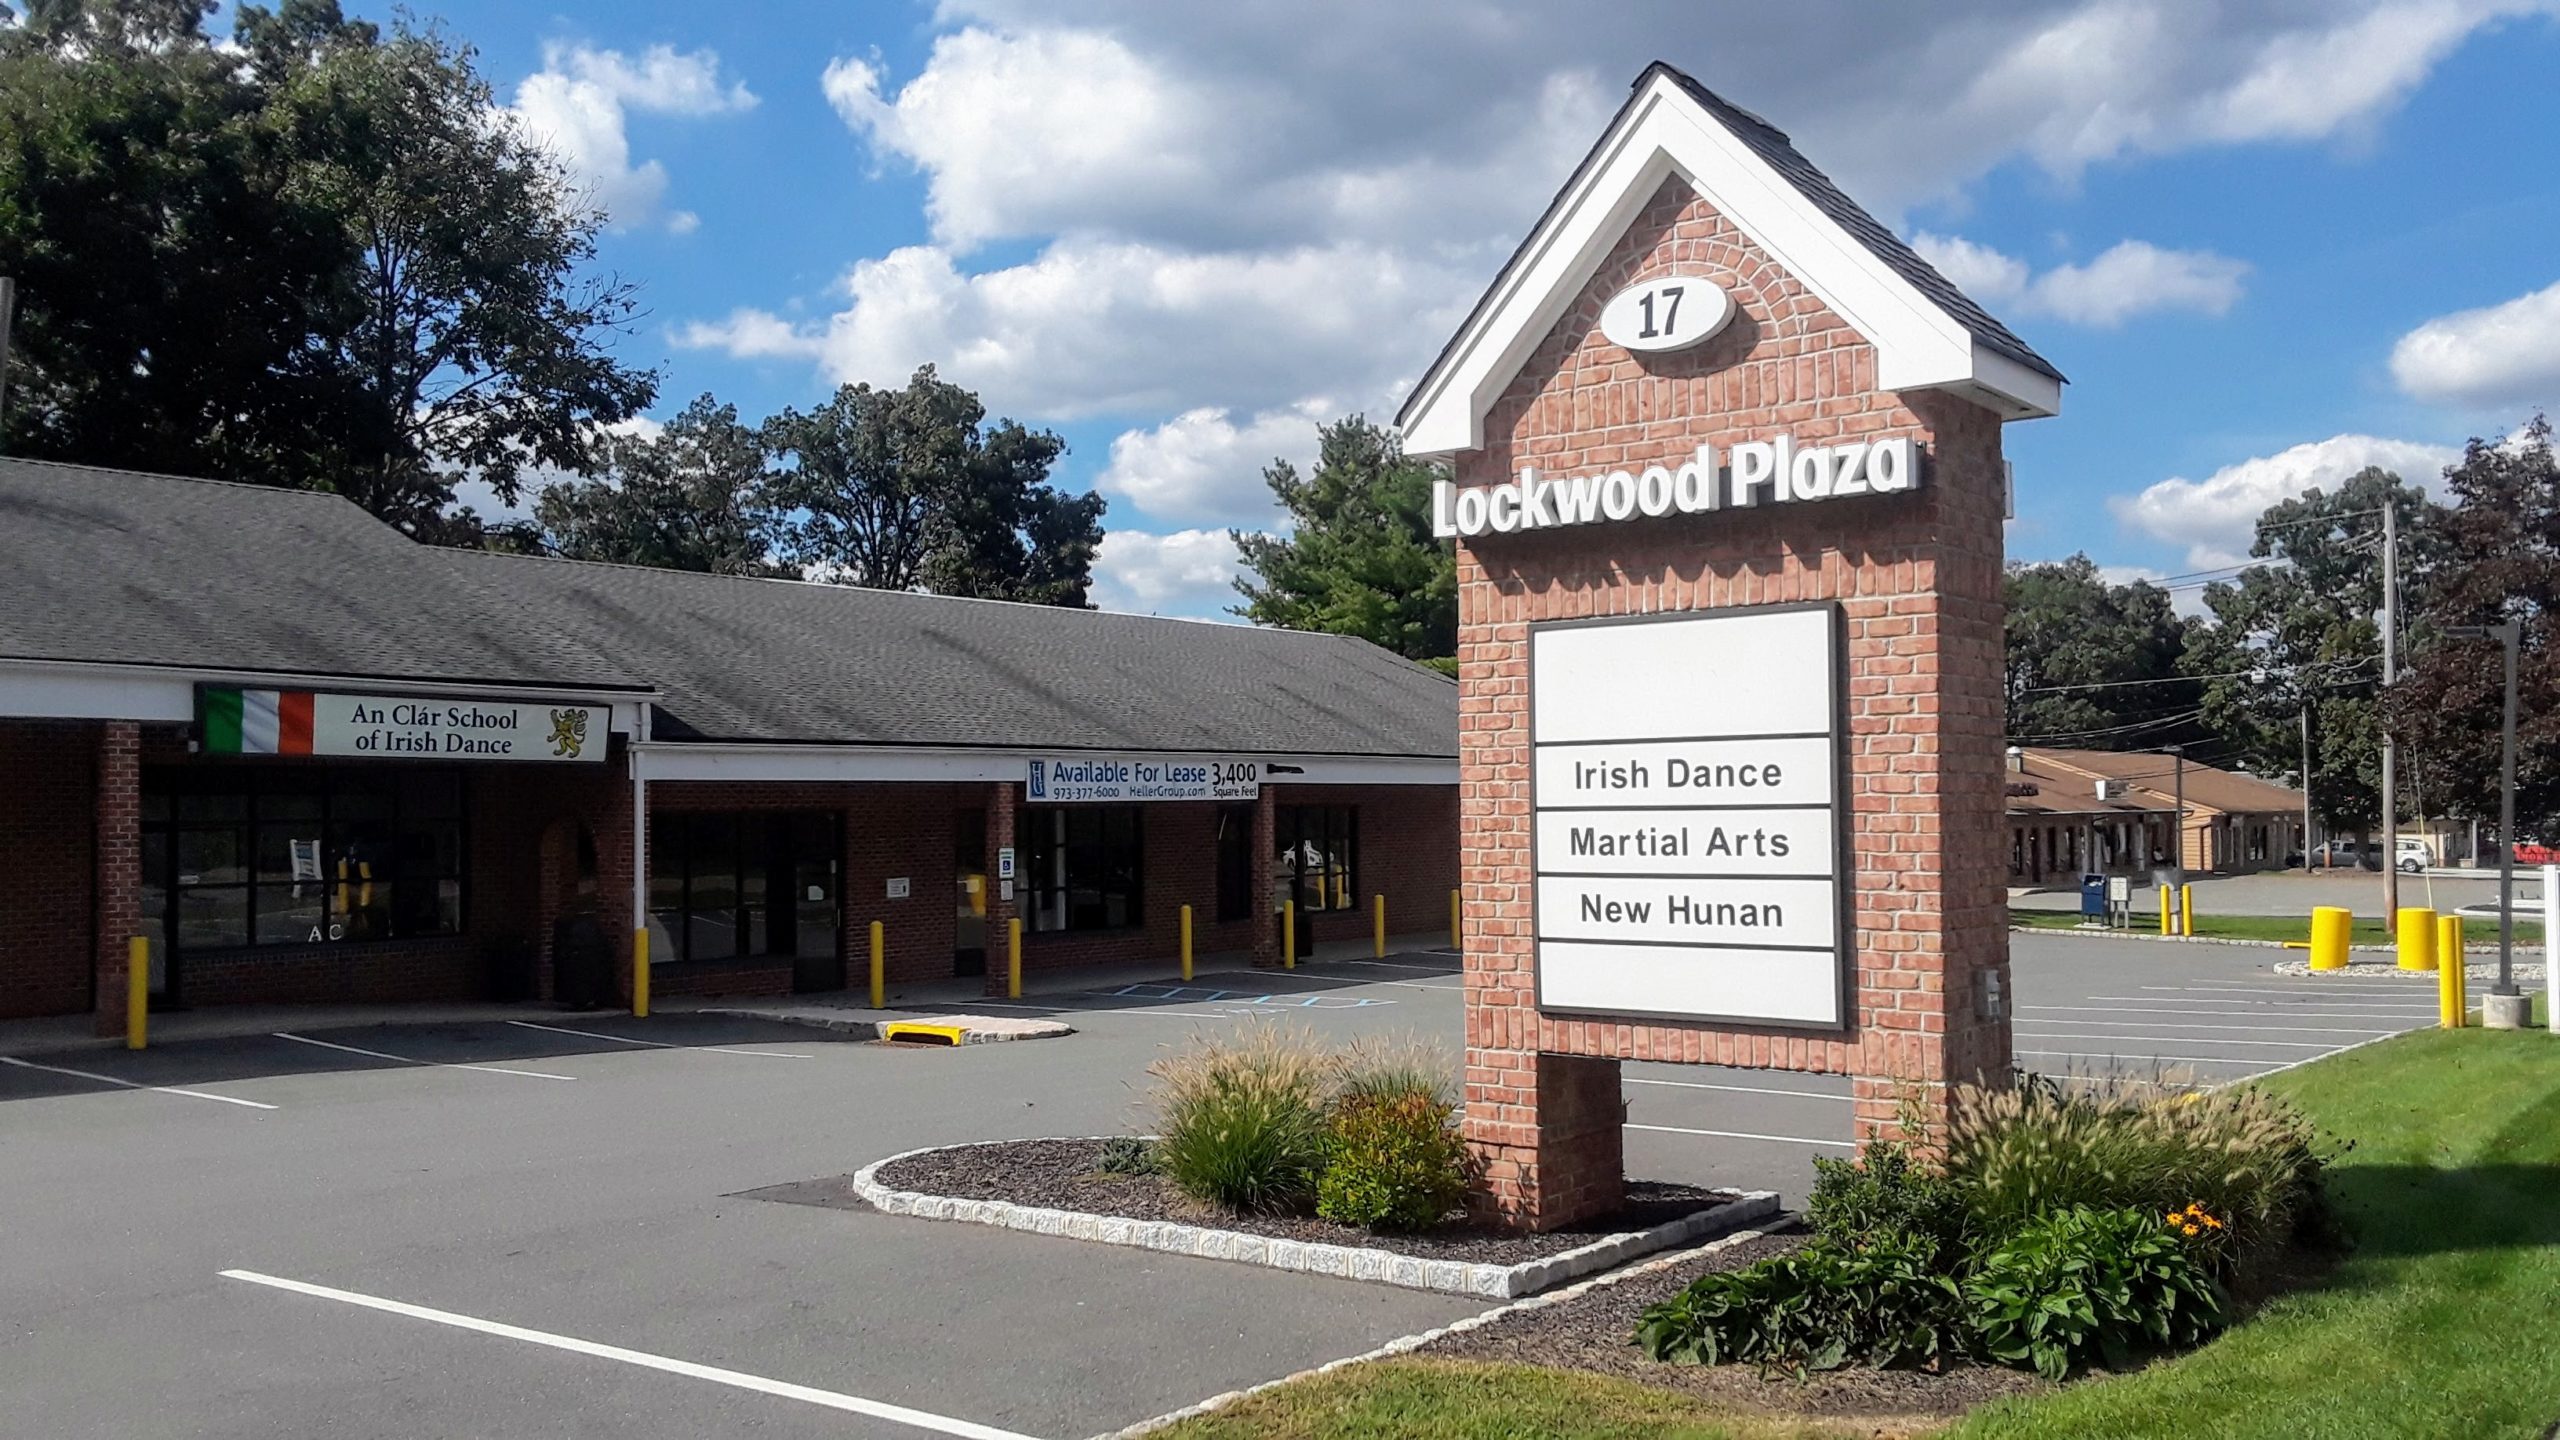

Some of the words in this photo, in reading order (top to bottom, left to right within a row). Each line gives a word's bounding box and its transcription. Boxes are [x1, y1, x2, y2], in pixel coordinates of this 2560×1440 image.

[1637, 287, 1684, 338] 17
[1432, 444, 1717, 538] Lockwood
[1730, 433, 1917, 507] Plaza
[350, 703, 385, 724] An
[392, 705, 441, 726] Clár
[447, 707, 518, 730] School
[355, 729, 381, 750] of
[385, 731, 438, 752] Irish
[445, 733, 512, 753] Dance
[1053, 761, 1129, 783] Available
[1135, 763, 1160, 783] For
[1165, 763, 1206, 783] Lease
[1211, 763, 1257, 785] 3,400
[1575, 760, 1649, 789] Irish
[1667, 758, 1782, 788] Dance
[1053, 786, 1120, 800] 973-377-6000
[1129, 785, 1206, 799] HellerGroup.com
[1213, 786, 1240, 799] Square
[1570, 827, 1689, 856] Martial
[1705, 827, 1790, 857] Arts
[1580, 894, 1651, 923] New
[1668, 895, 1783, 927] Hunan
